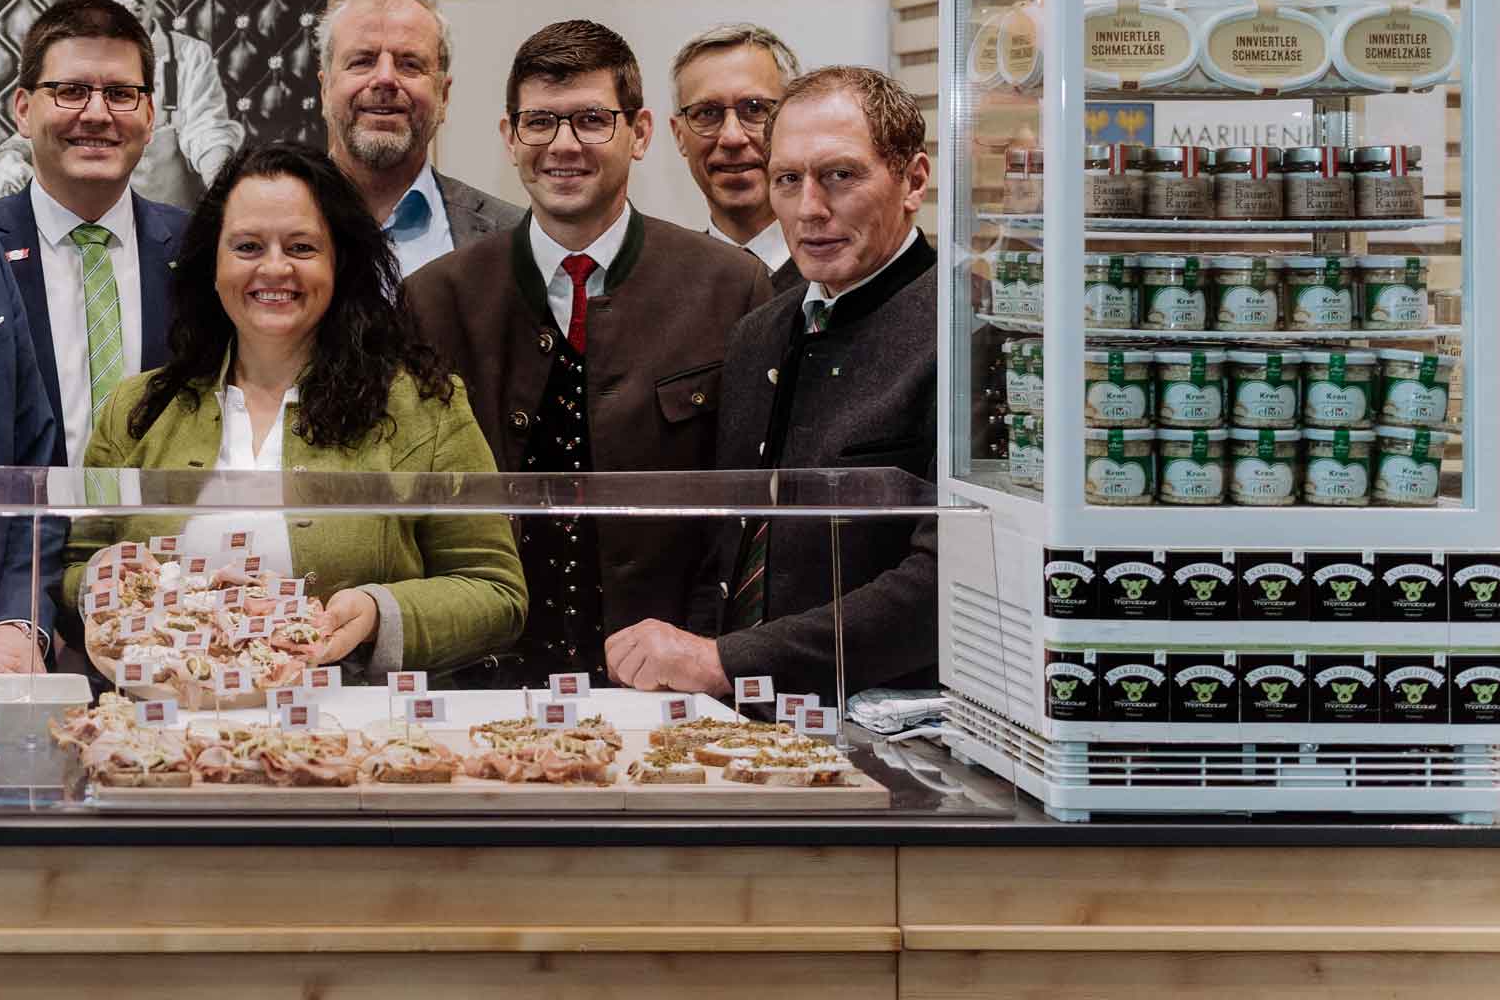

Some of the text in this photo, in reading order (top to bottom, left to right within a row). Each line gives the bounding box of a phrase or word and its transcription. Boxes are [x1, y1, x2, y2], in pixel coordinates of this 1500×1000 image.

[1096, 31, 1160, 42] INNVIERTLER
[1235, 36, 1298, 48] INNVIERTLER
[1368, 33, 1427, 44] INNVIERTLER
[1092, 42, 1164, 56] SCHMELZKÄSE
[1365, 46, 1432, 59] SCHMELZKÄSE
